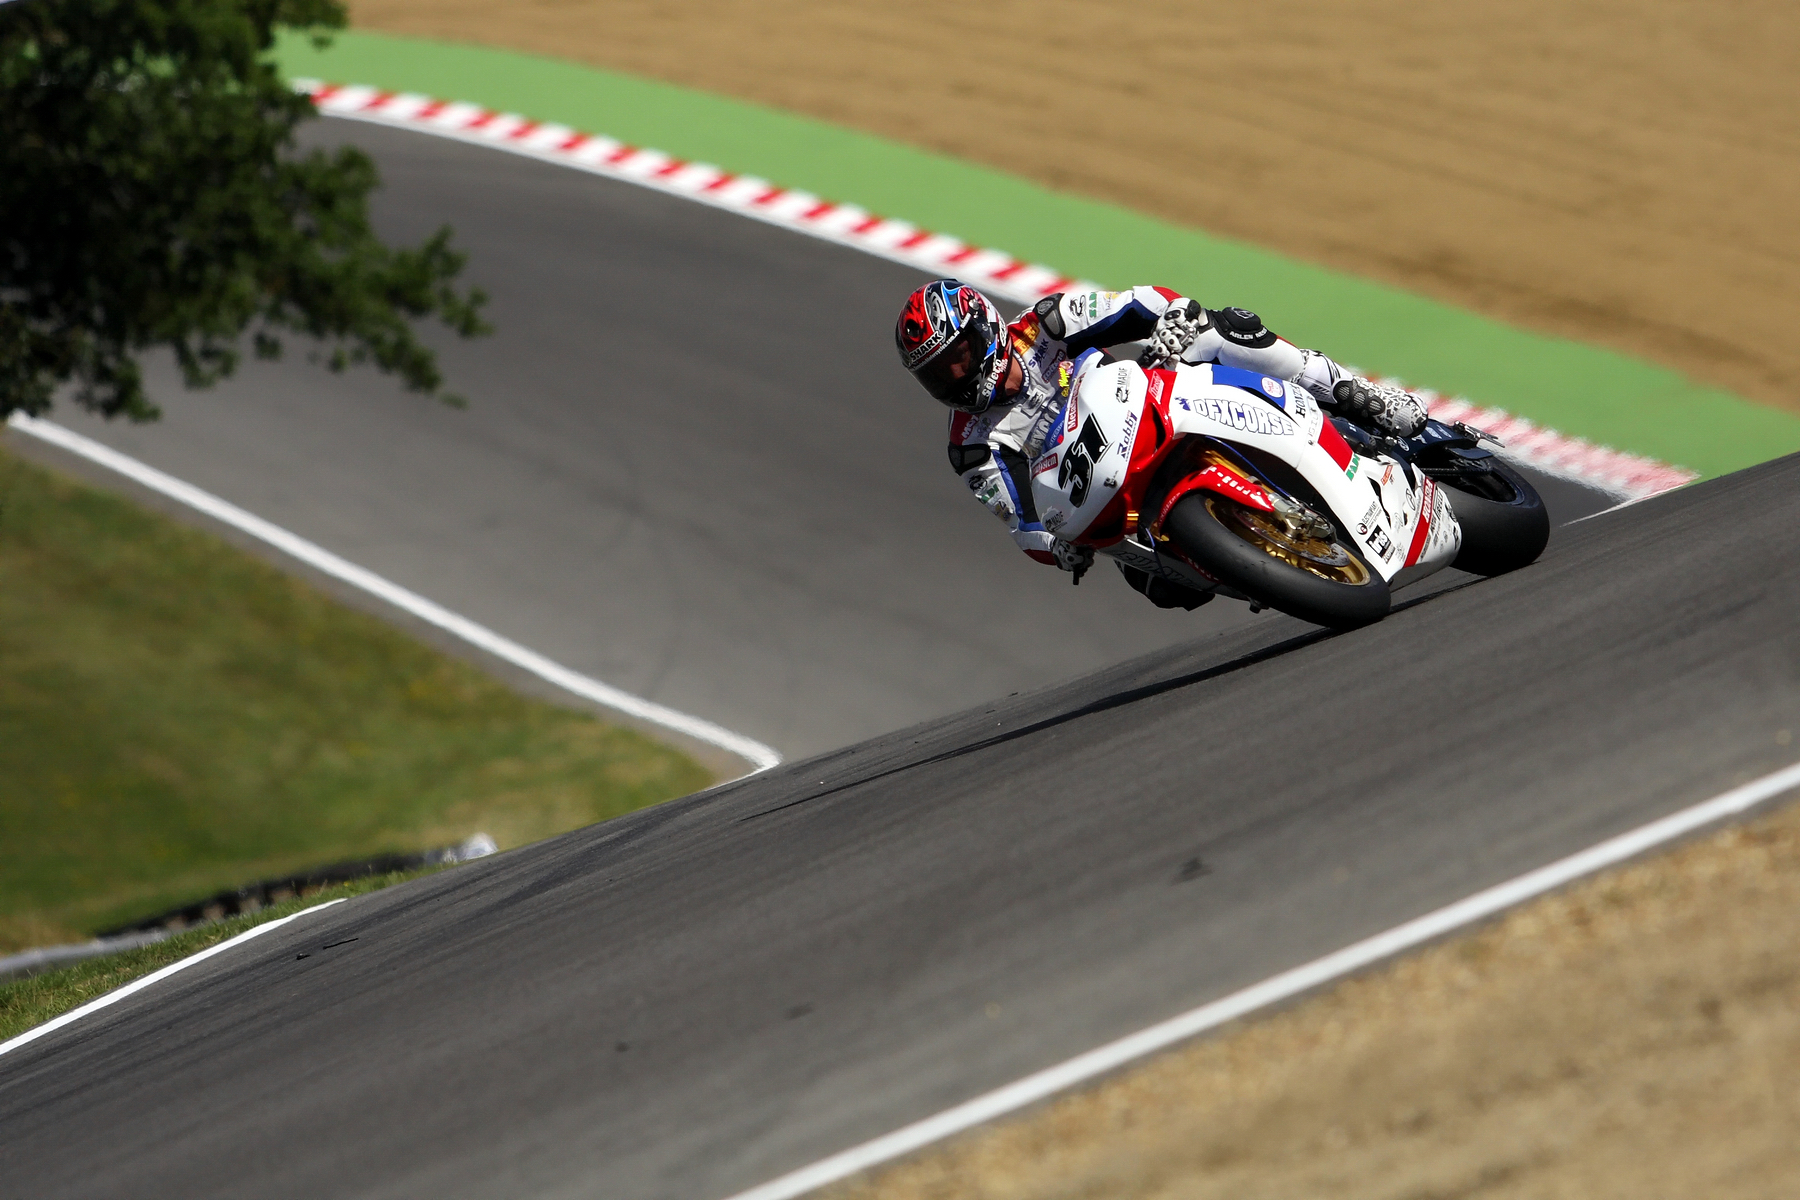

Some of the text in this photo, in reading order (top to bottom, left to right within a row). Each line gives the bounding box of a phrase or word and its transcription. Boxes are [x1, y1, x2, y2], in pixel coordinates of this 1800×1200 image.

[908, 330, 944, 362] SHARK
[1229, 330, 1253, 339] ARLEN
[1192, 399, 1295, 436] DFXCORSE
[1117, 410, 1139, 460] Robby
[1057, 411, 1110, 508] 31
[1368, 530, 1390, 554] iris
